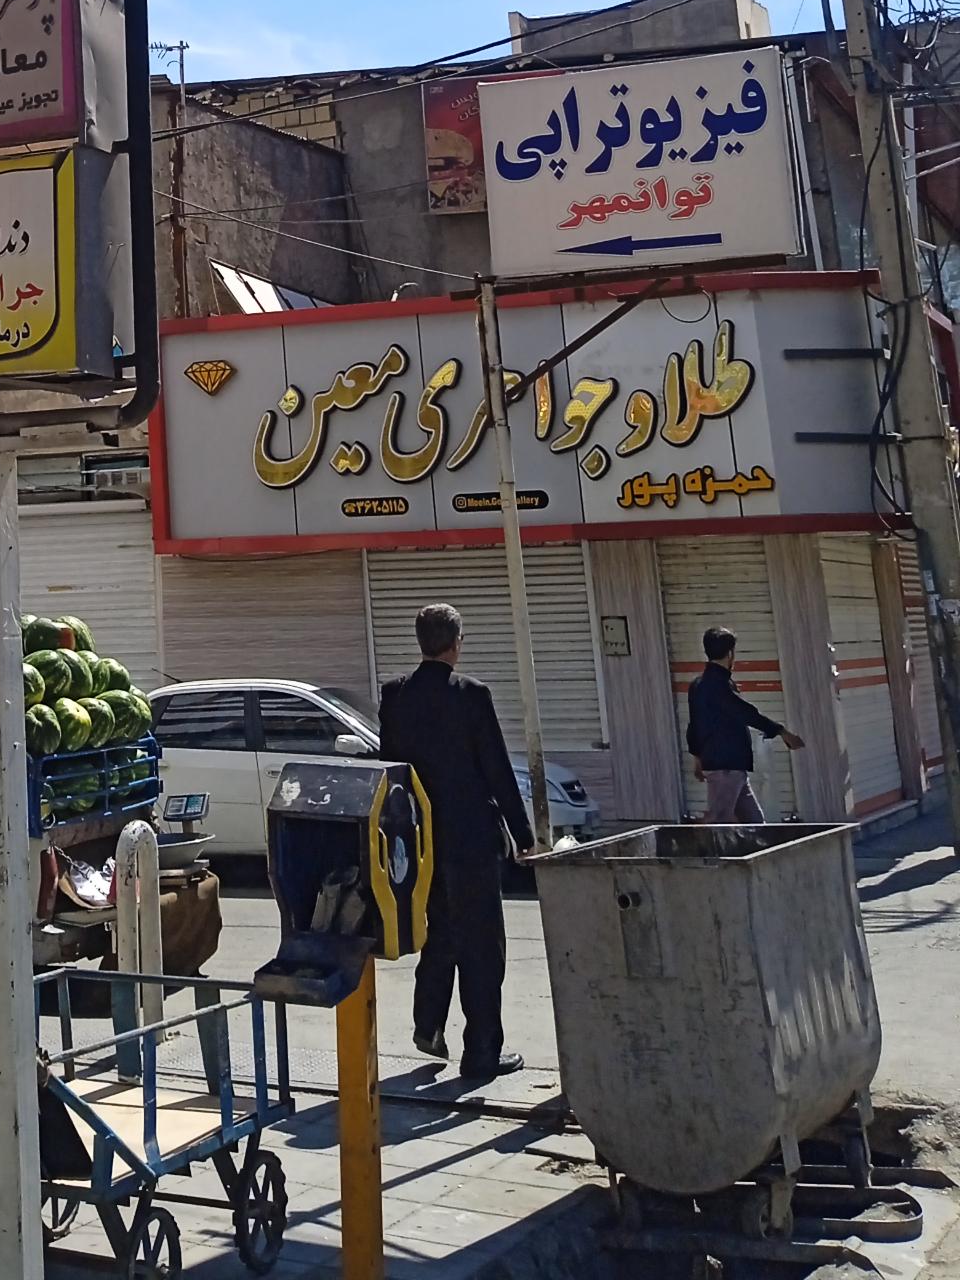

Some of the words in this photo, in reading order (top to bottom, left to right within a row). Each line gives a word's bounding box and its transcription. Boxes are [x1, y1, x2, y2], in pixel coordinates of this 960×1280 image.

[18, 89, 59, 111] تجویز
[495, 58, 769, 182] فیزیوتراپی
[557, 174, 714, 230] توانمهر
[662, 320, 755, 447] طلا
[253, 343, 411, 489] معین
[617, 388, 657, 458] و
[617, 471, 679, 509] پور
[683, 464, 776, 506] حمزه
